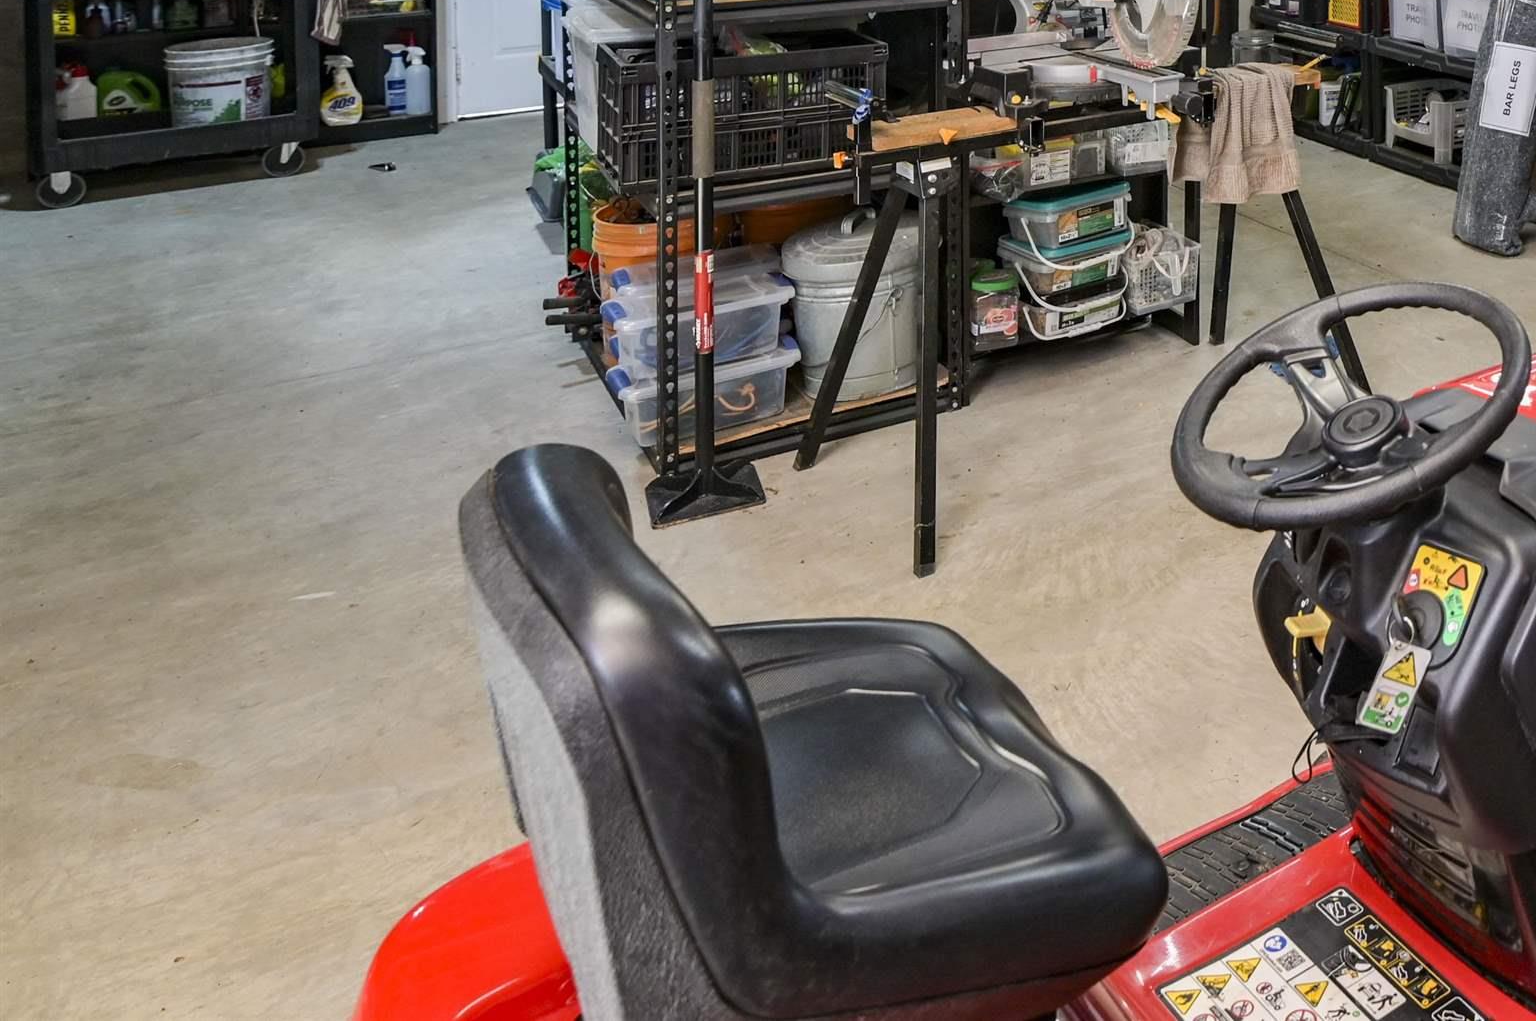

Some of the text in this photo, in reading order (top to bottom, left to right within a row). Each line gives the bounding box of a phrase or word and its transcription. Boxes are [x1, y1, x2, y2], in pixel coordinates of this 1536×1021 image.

[329, 95, 356, 112] 409
[1502, 59, 1522, 117] BAR LEGS
